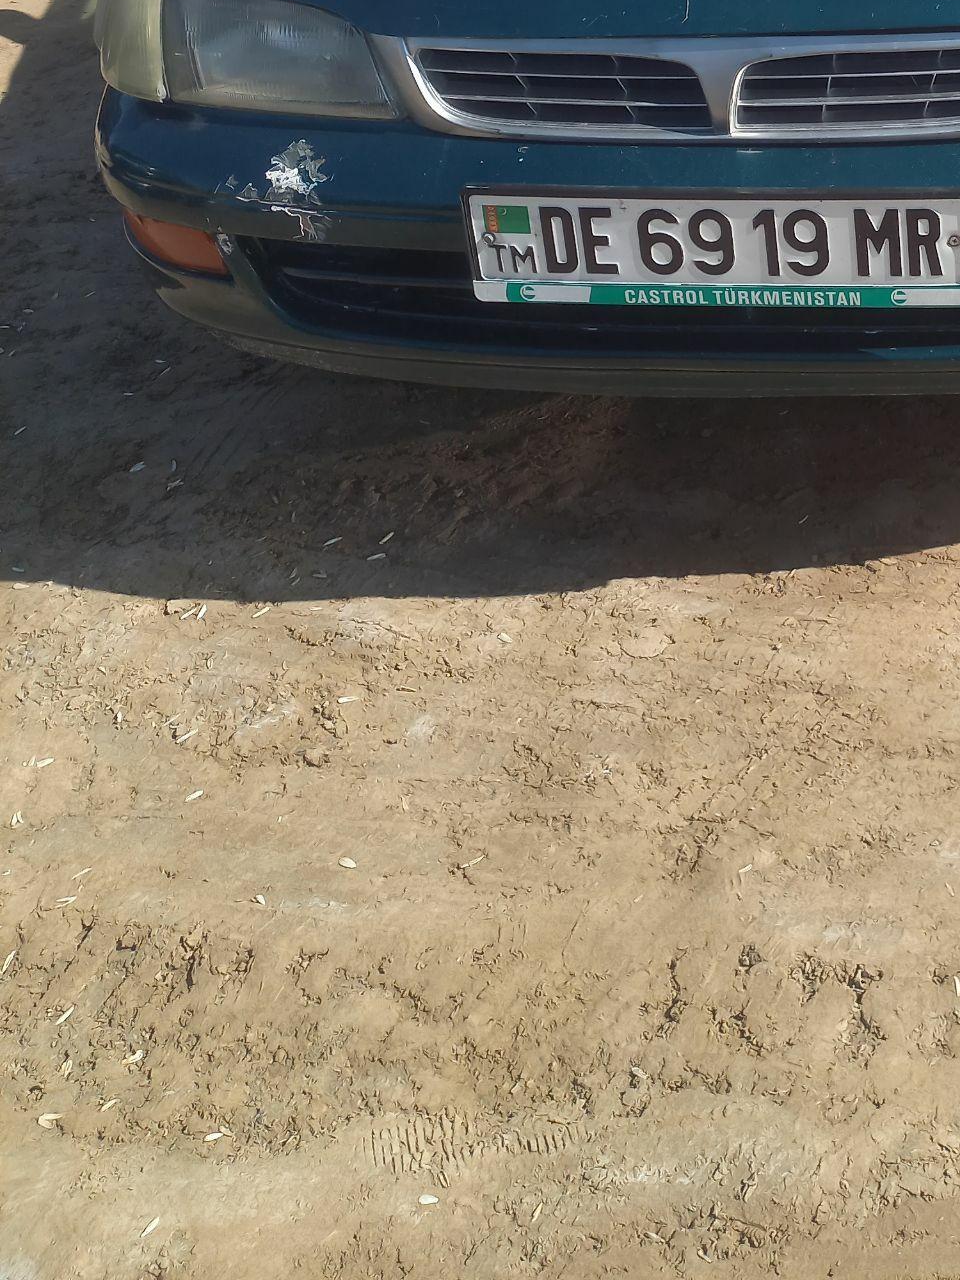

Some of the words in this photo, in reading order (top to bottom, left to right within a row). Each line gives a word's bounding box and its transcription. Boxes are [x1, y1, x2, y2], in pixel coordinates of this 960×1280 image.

[538, 206, 619, 274] DE
[854, 208, 943, 277] MR
[489, 243, 538, 273] TM
[624, 289, 708, 305] CASTROL
[712, 287, 861, 306] TÜRKMENISTAN
